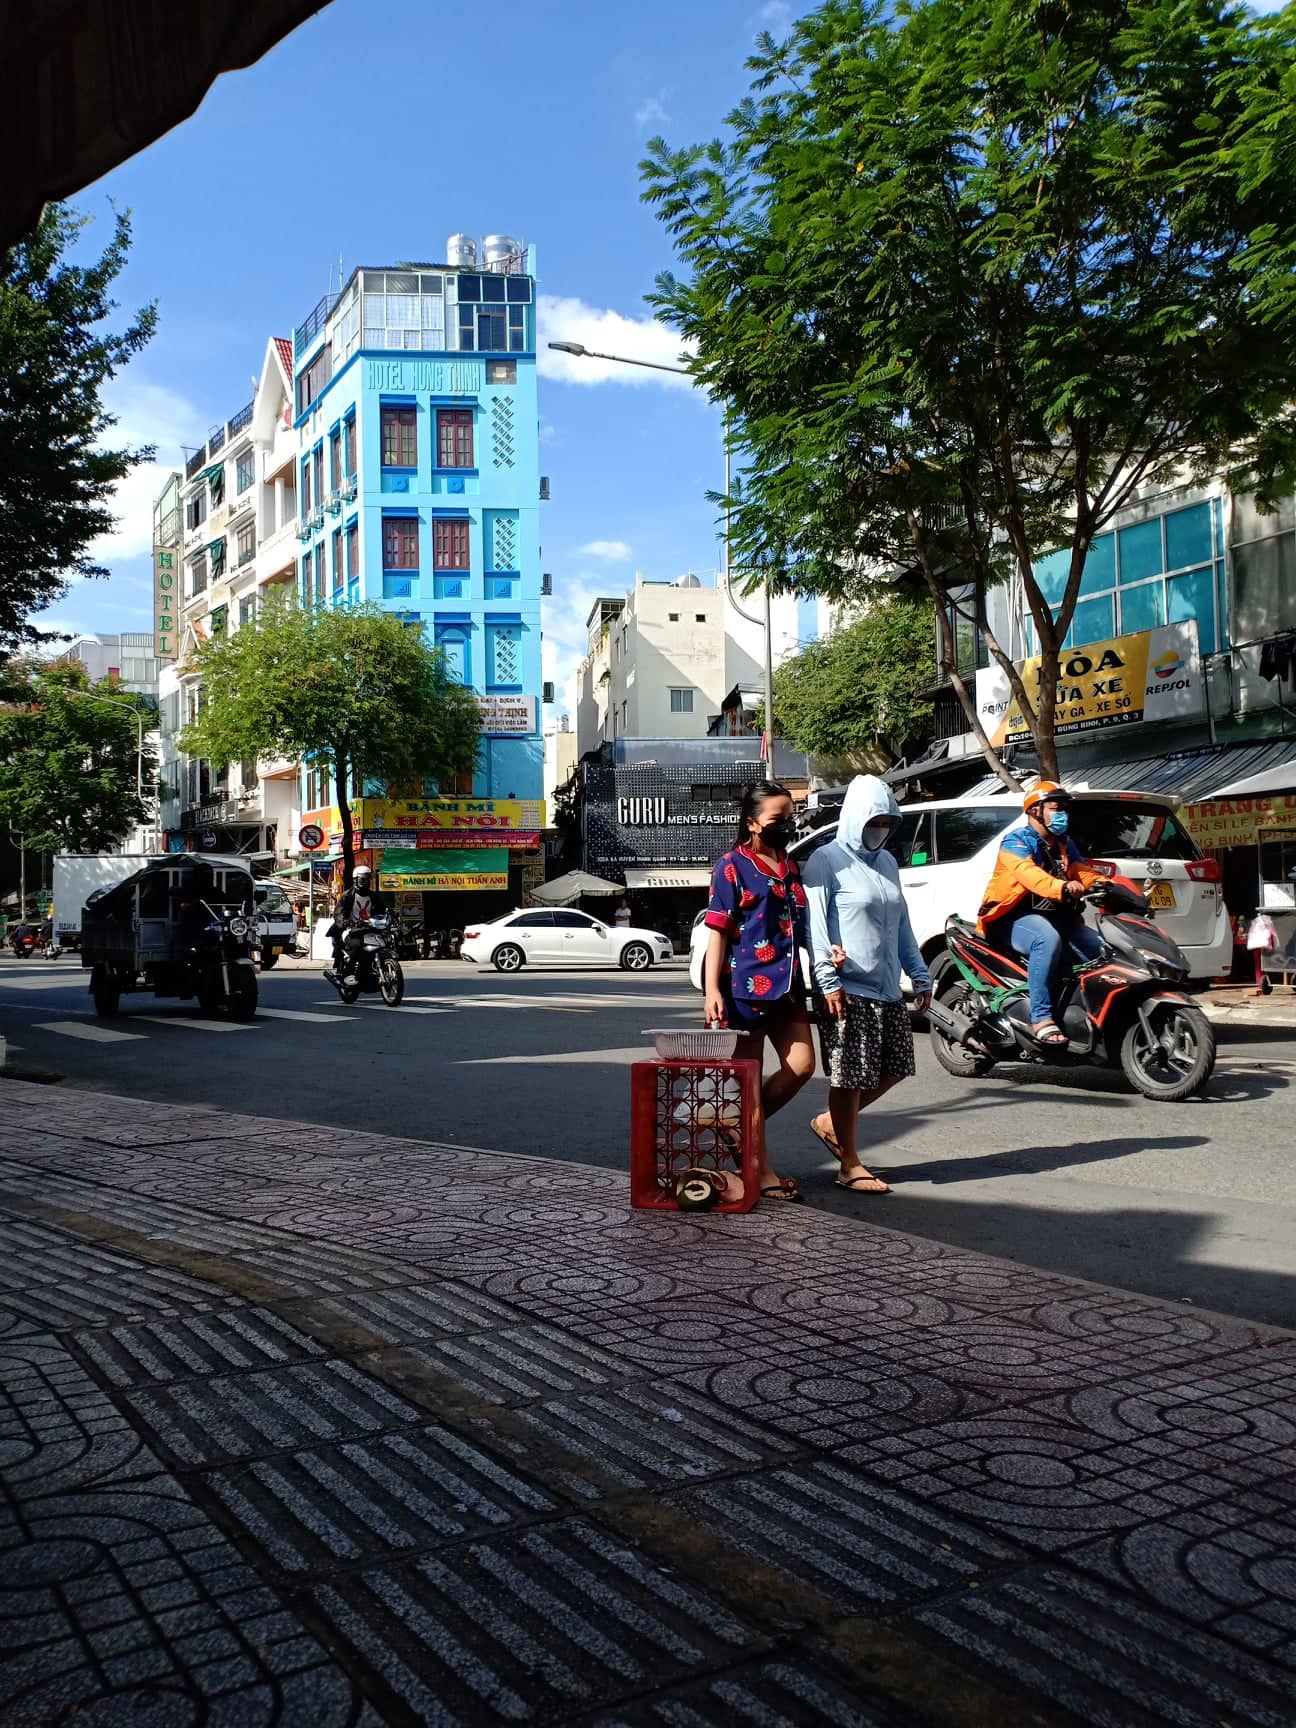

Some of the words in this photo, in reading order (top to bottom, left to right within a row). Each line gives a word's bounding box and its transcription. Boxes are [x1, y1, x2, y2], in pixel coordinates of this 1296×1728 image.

[368, 360, 405, 391] HOTEL
[158, 551, 174, 654] HOTEL
[1093, 678, 1123, 698] XE
[1145, 679, 1192, 696] REPSOL
[1070, 706, 1086, 718] GA
[1096, 702, 1111, 714] XE
[617, 797, 666, 825] GURU
[667, 814, 698, 824] MEN'S
[1183, 798, 1273, 819] TRANG
[489, 876, 506, 885] ANH
